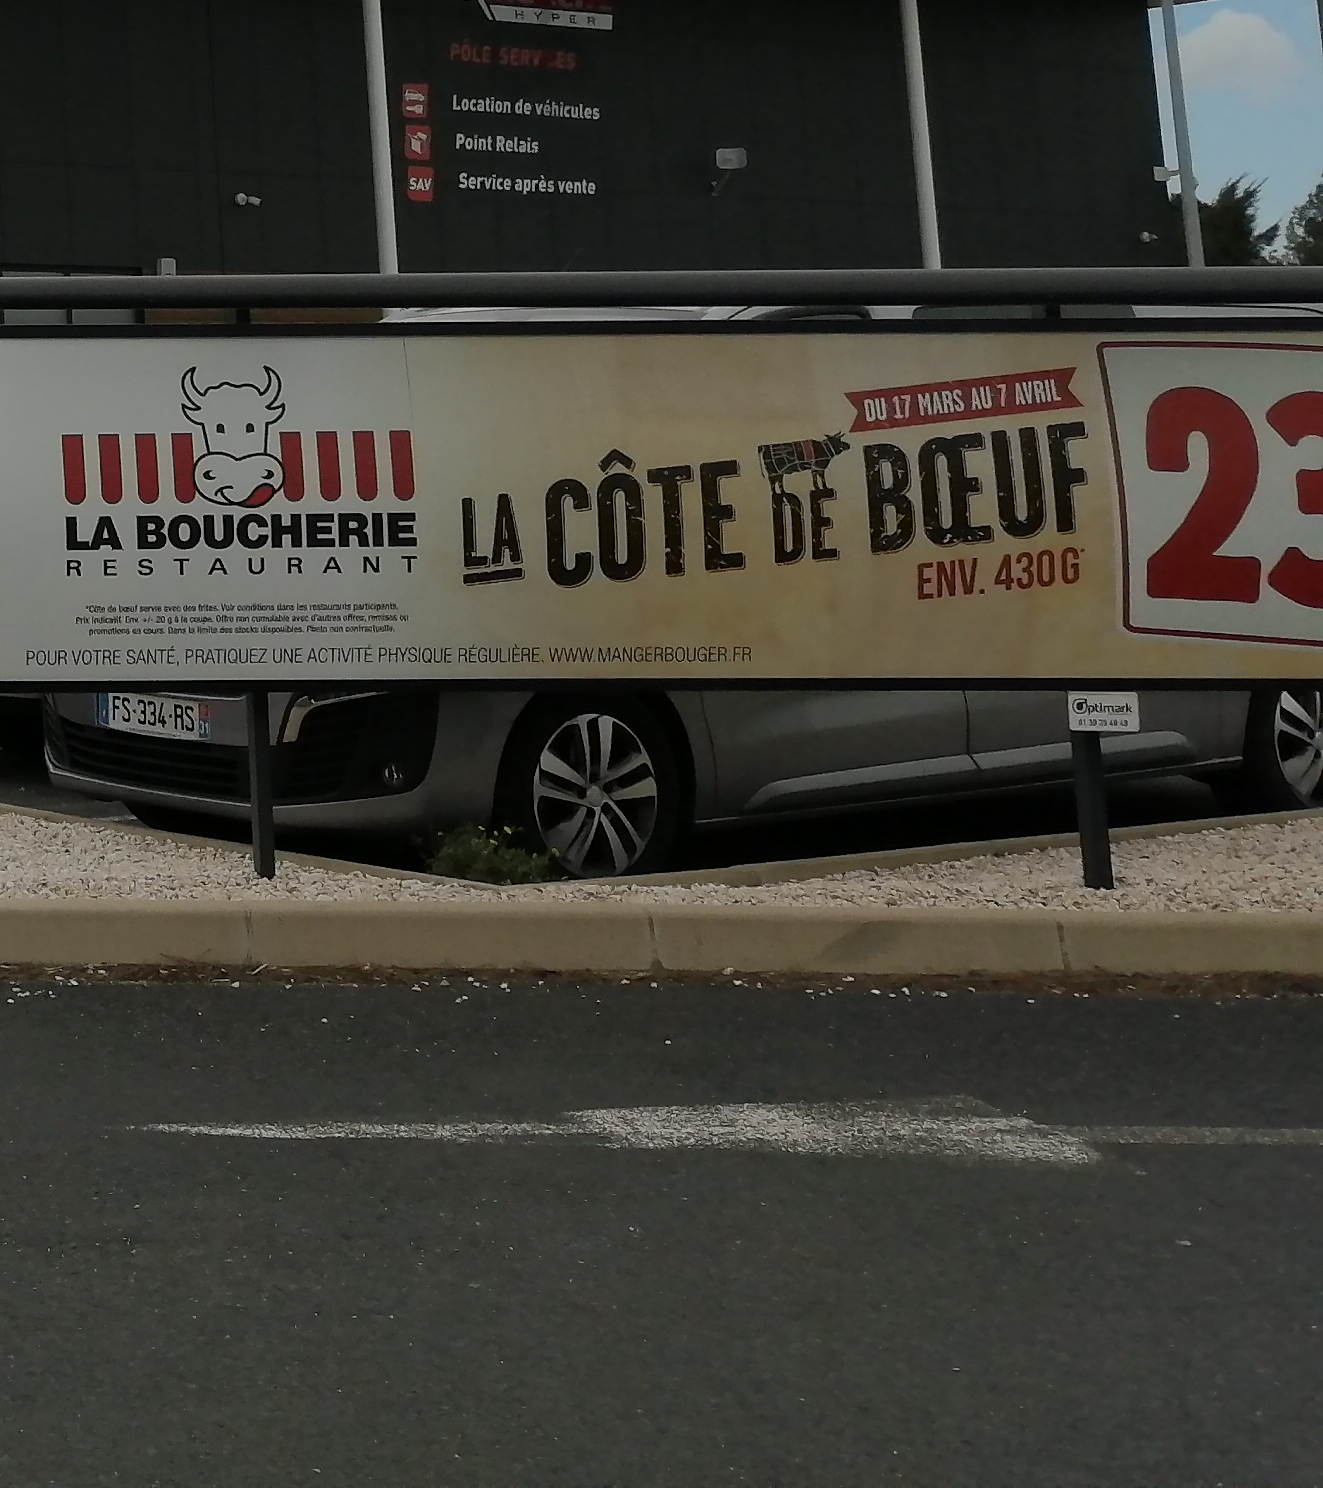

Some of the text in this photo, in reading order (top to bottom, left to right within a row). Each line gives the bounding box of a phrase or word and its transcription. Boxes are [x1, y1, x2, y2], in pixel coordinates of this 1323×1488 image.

[515, 10, 596, 26] HYPER
[499, 47, 577, 71] SERVES
[452, 94, 601, 120] Location de véhicules
[455, 133, 540, 154] Point Relais
[409, 177, 433, 192] SAV
[458, 172, 597, 196] Service après vente
[863, 378, 1062, 422] DU 17 MARS AU 7 AVRIL
[462, 493, 523, 568] LA
[545, 448, 747, 589] CÔTE
[771, 488, 841, 565] DE
[66, 513, 418, 551] LA BOUCHERIE
[66, 556, 418, 577] RESTAURANT
[917, 558, 985, 600] ENV.
[26, 650, 68, 666] POUR
[72, 650, 122, 665] VOTRE
[126, 645, 180, 667] SANTÉ,
[185, 648, 269, 665] PRATIQUEZ
[273, 648, 303, 664] UNE
[307, 644, 373, 664] ACTIVITÉ
[379, 647, 452, 664] PHYSIQUE
[549, 646, 752, 663] WWW.MANGERBOUGER.FR
[112, 695, 195, 732] FS-334-RS
